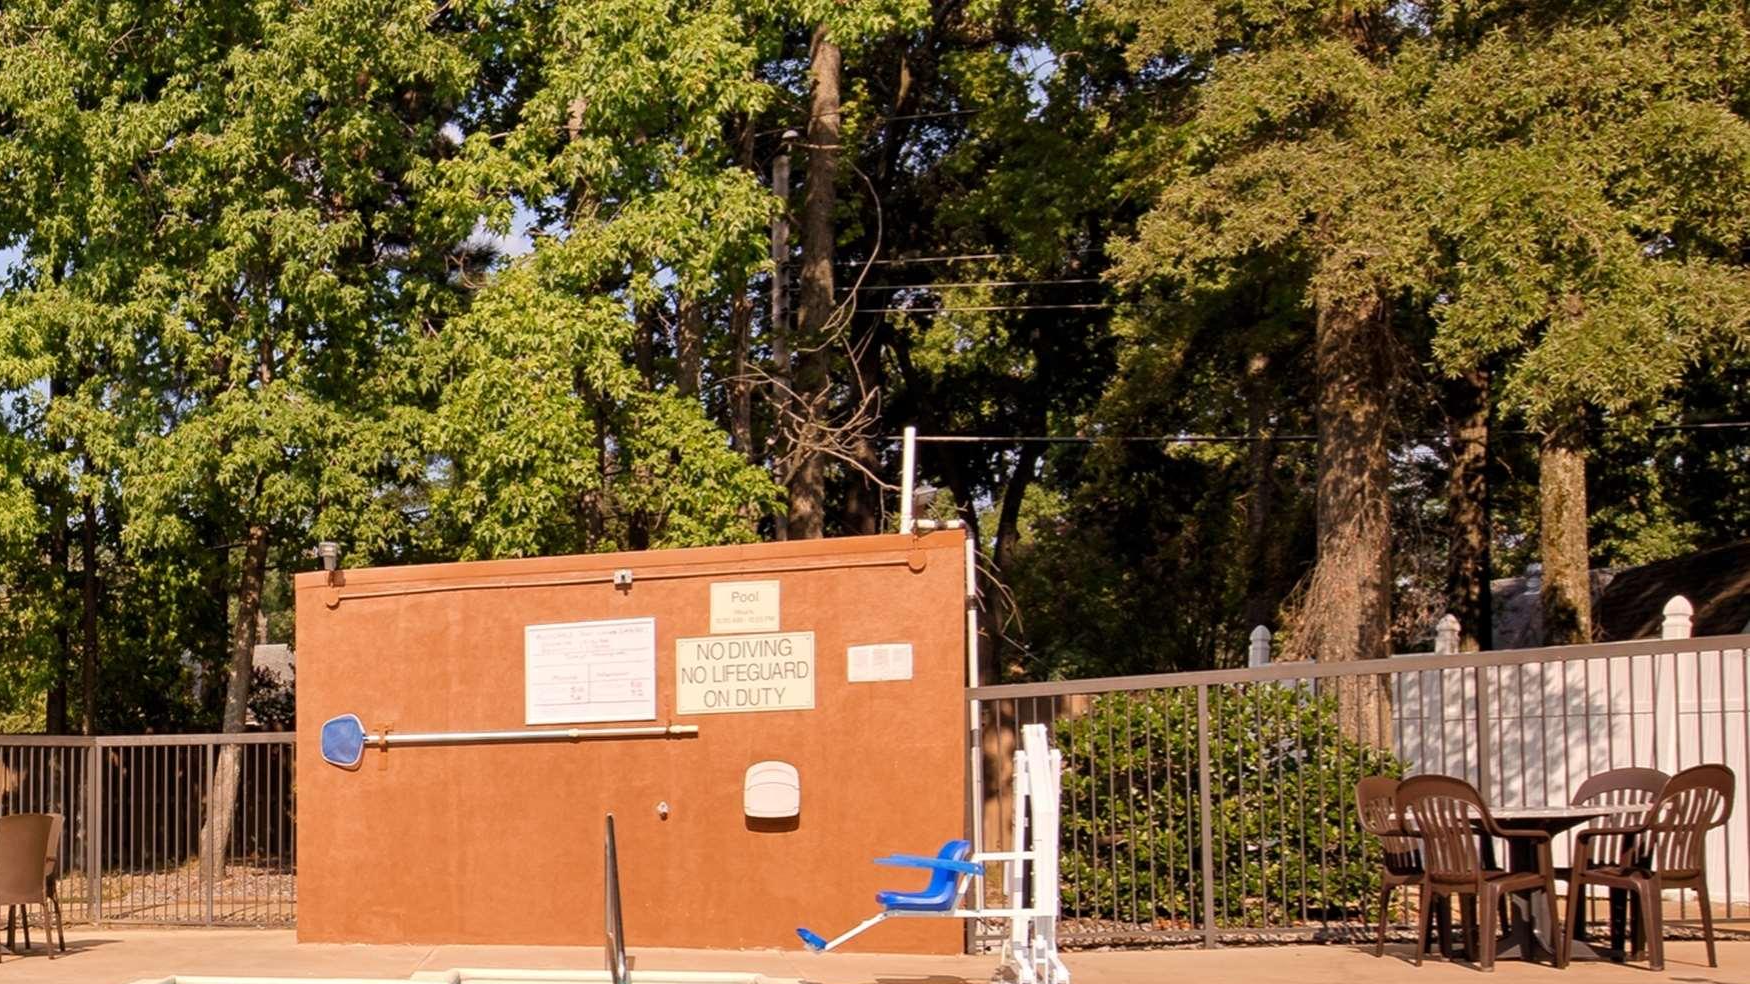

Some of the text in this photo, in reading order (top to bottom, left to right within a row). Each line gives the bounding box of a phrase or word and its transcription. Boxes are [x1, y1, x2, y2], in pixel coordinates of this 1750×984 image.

[731, 591, 759, 603] Pool
[696, 638, 792, 660] NO DIVING
[681, 661, 809, 684] NO LIFEGUARD
[704, 686, 786, 708] ON DUTY
